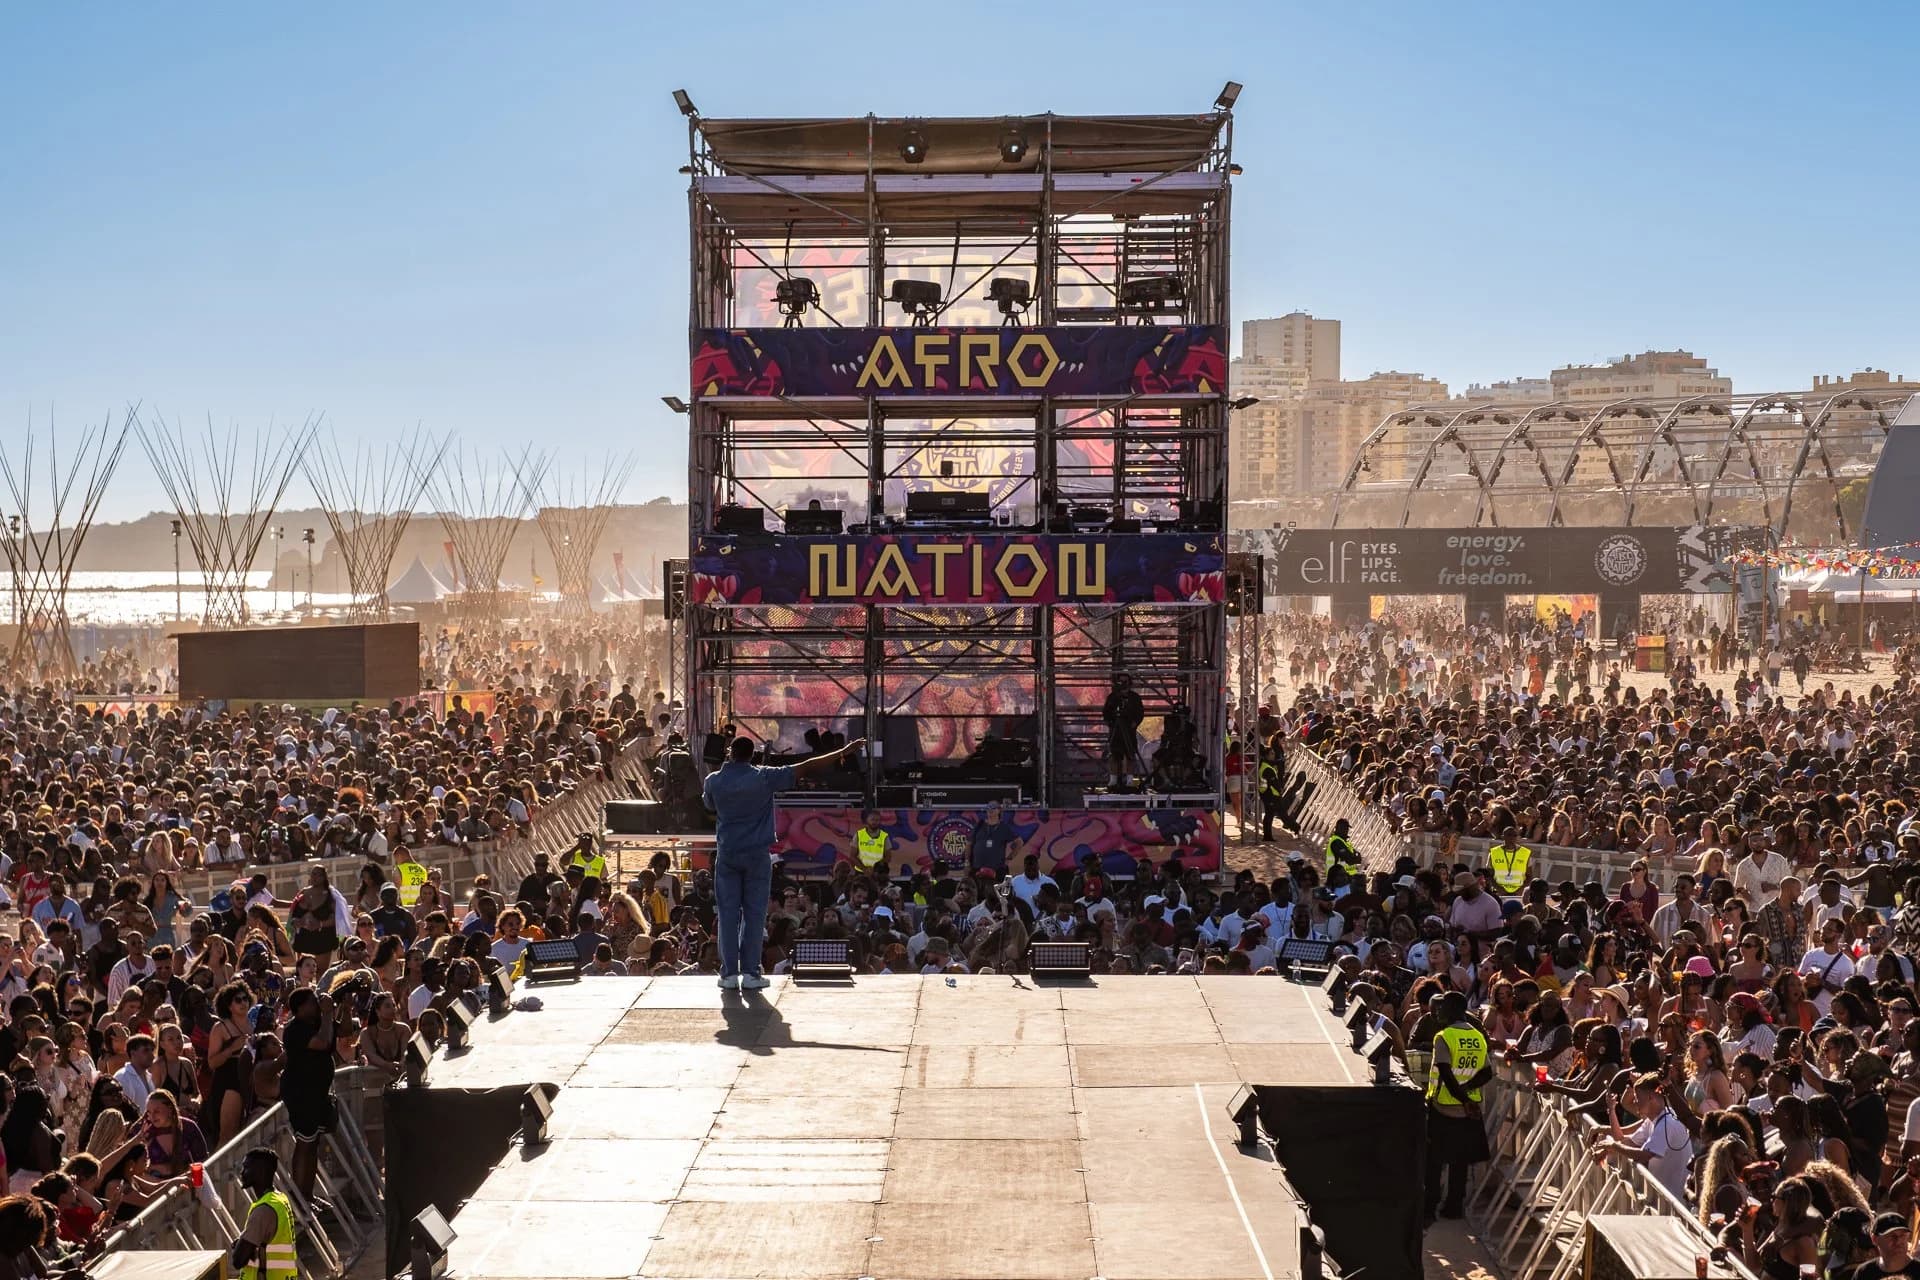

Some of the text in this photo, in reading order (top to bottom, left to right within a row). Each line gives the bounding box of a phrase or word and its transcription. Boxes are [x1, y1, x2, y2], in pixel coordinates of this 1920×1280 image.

[856, 334, 1060, 388] AFRO
[1361, 543, 1401, 554] EYES.
[1446, 535, 1526, 552] energy.
[1361, 557, 1397, 569] LIPS.
[1461, 548, 1512, 567] love.
[809, 544, 1105, 596] NATION
[1361, 571, 1401, 583] FACE.
[1437, 567, 1534, 585] freedom.
[1458, 1038, 1480, 1049] PSG
[1458, 1056, 1478, 1069] 906
